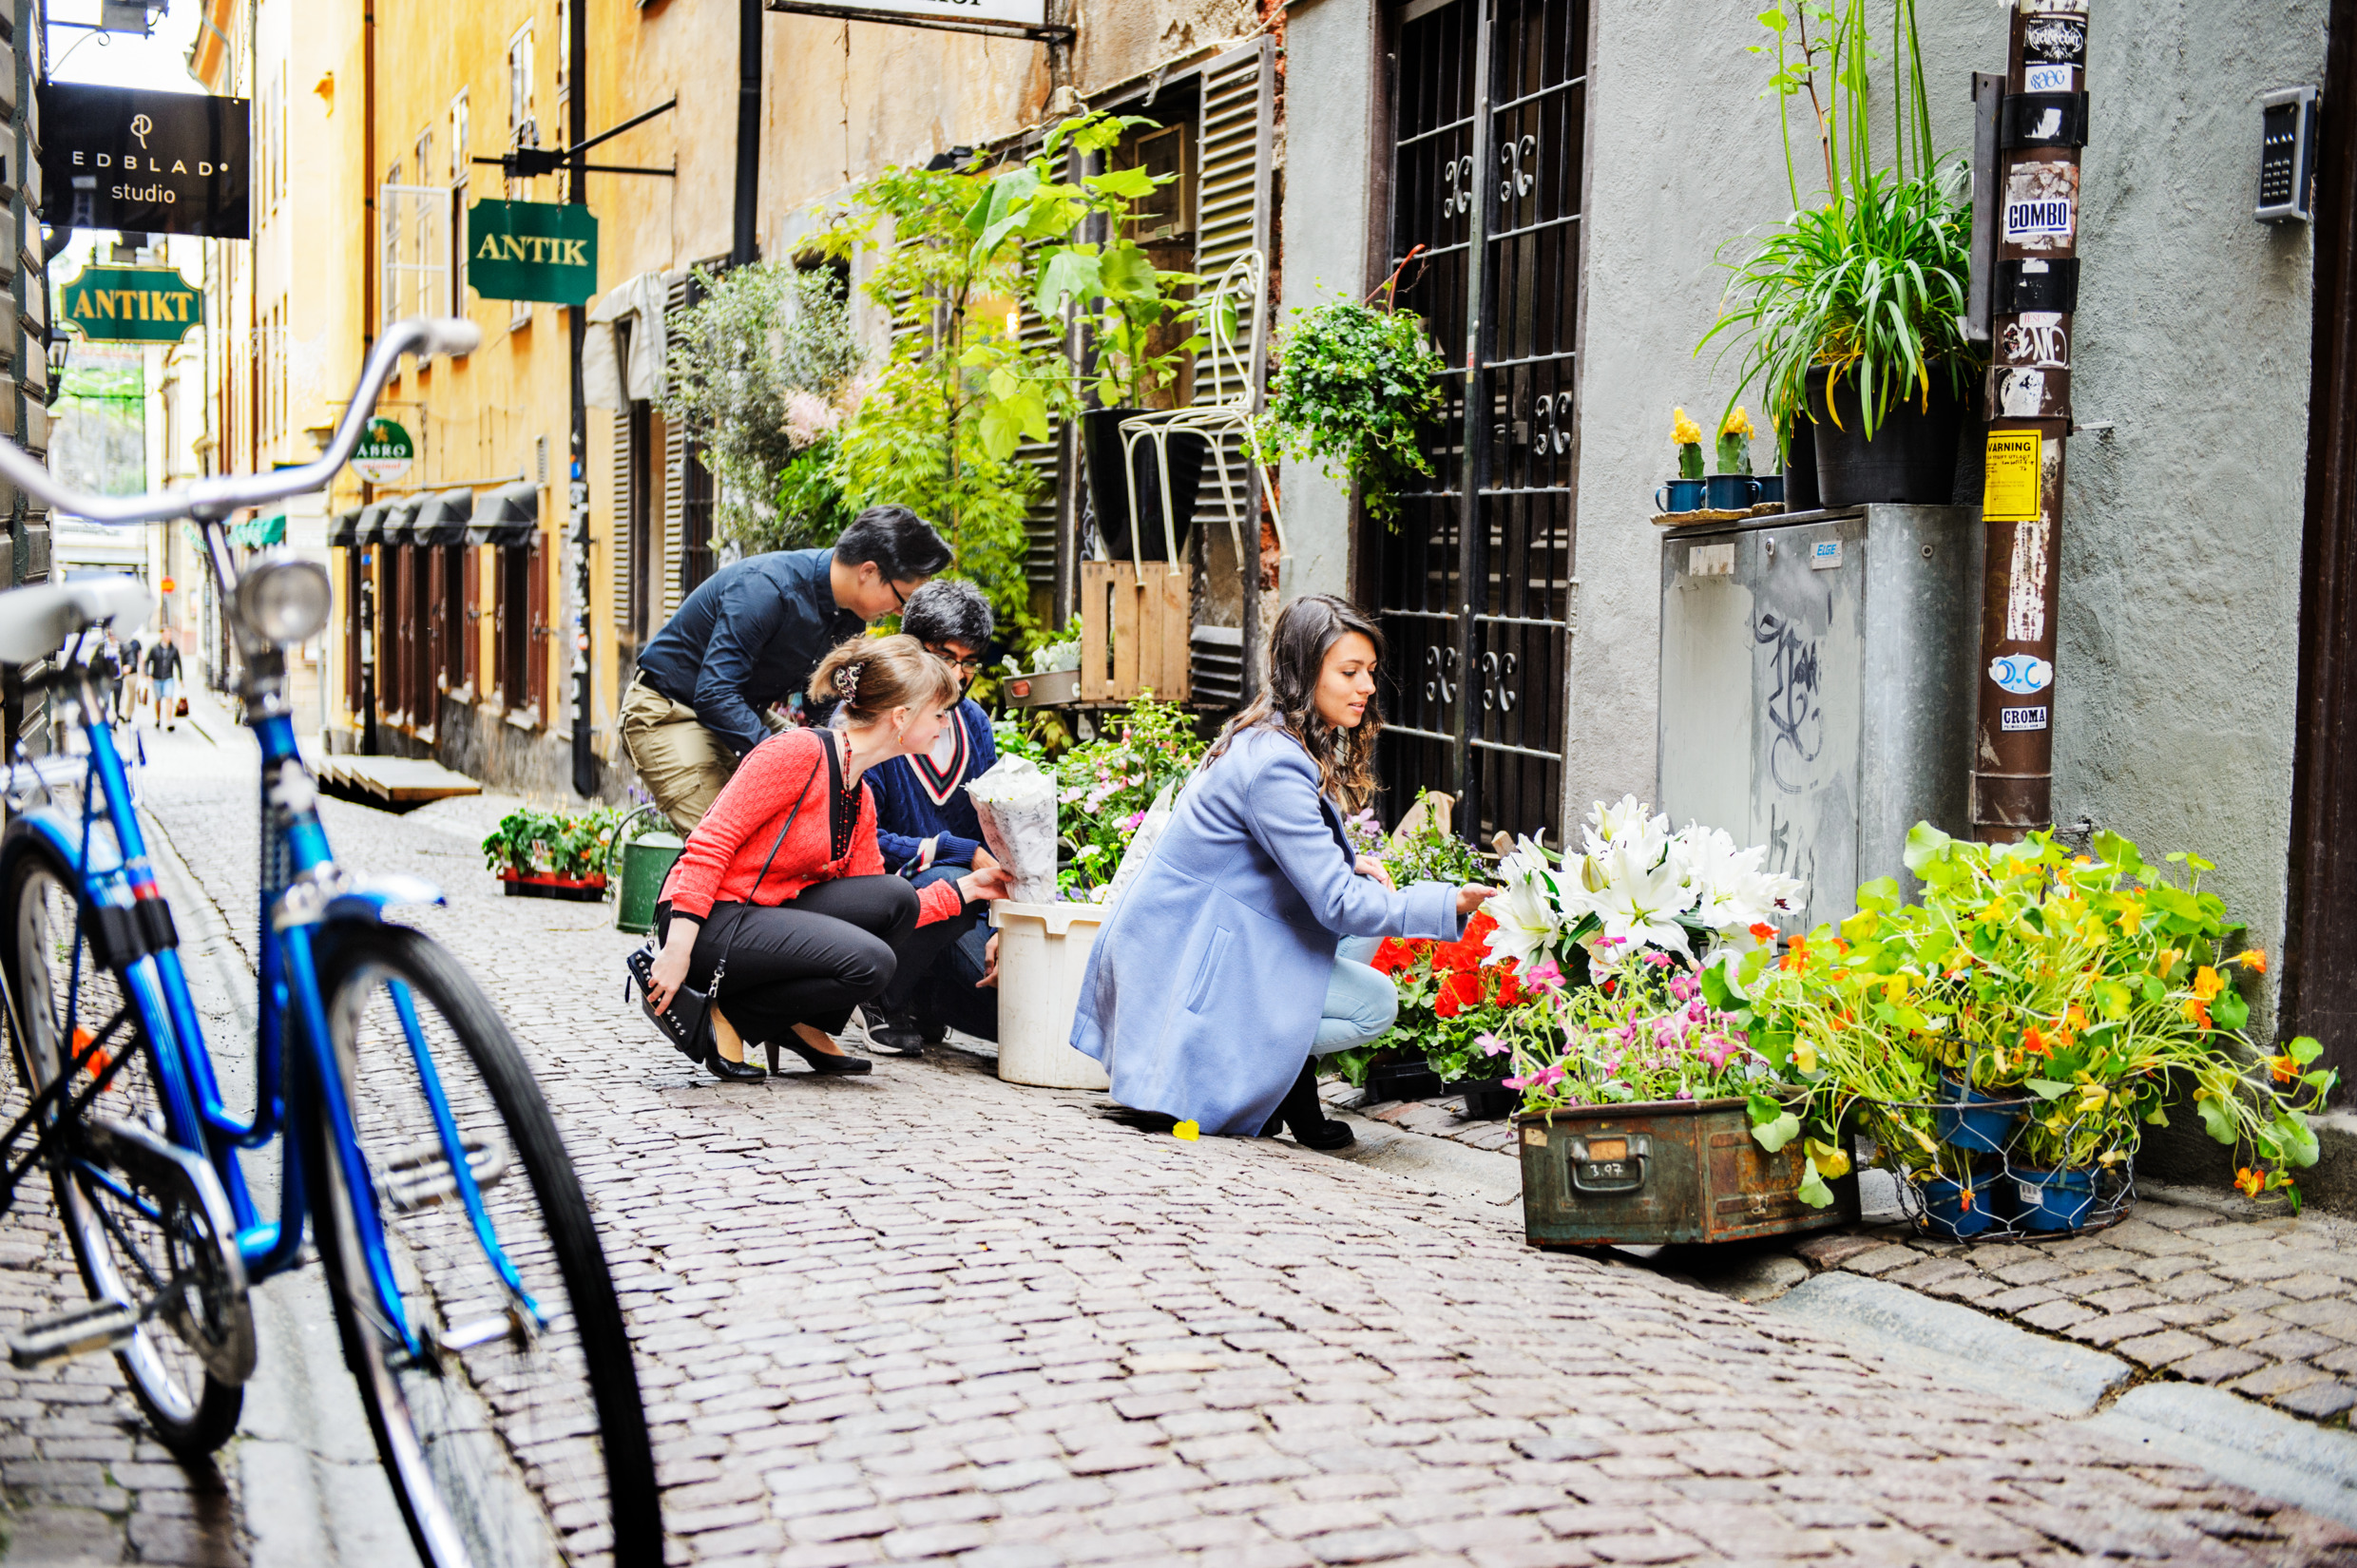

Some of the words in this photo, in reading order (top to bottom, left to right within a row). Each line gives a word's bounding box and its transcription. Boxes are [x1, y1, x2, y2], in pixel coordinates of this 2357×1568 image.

[72, 151, 213, 176] EDBLAD
[111, 183, 176, 203] studio
[2009, 202, 2067, 228] COMBO
[475, 233, 588, 266] ANTIK
[72, 288, 194, 321] ANTIKT
[1987, 442, 2031, 451] VARNING
[2003, 709, 2045, 724] CROMA
